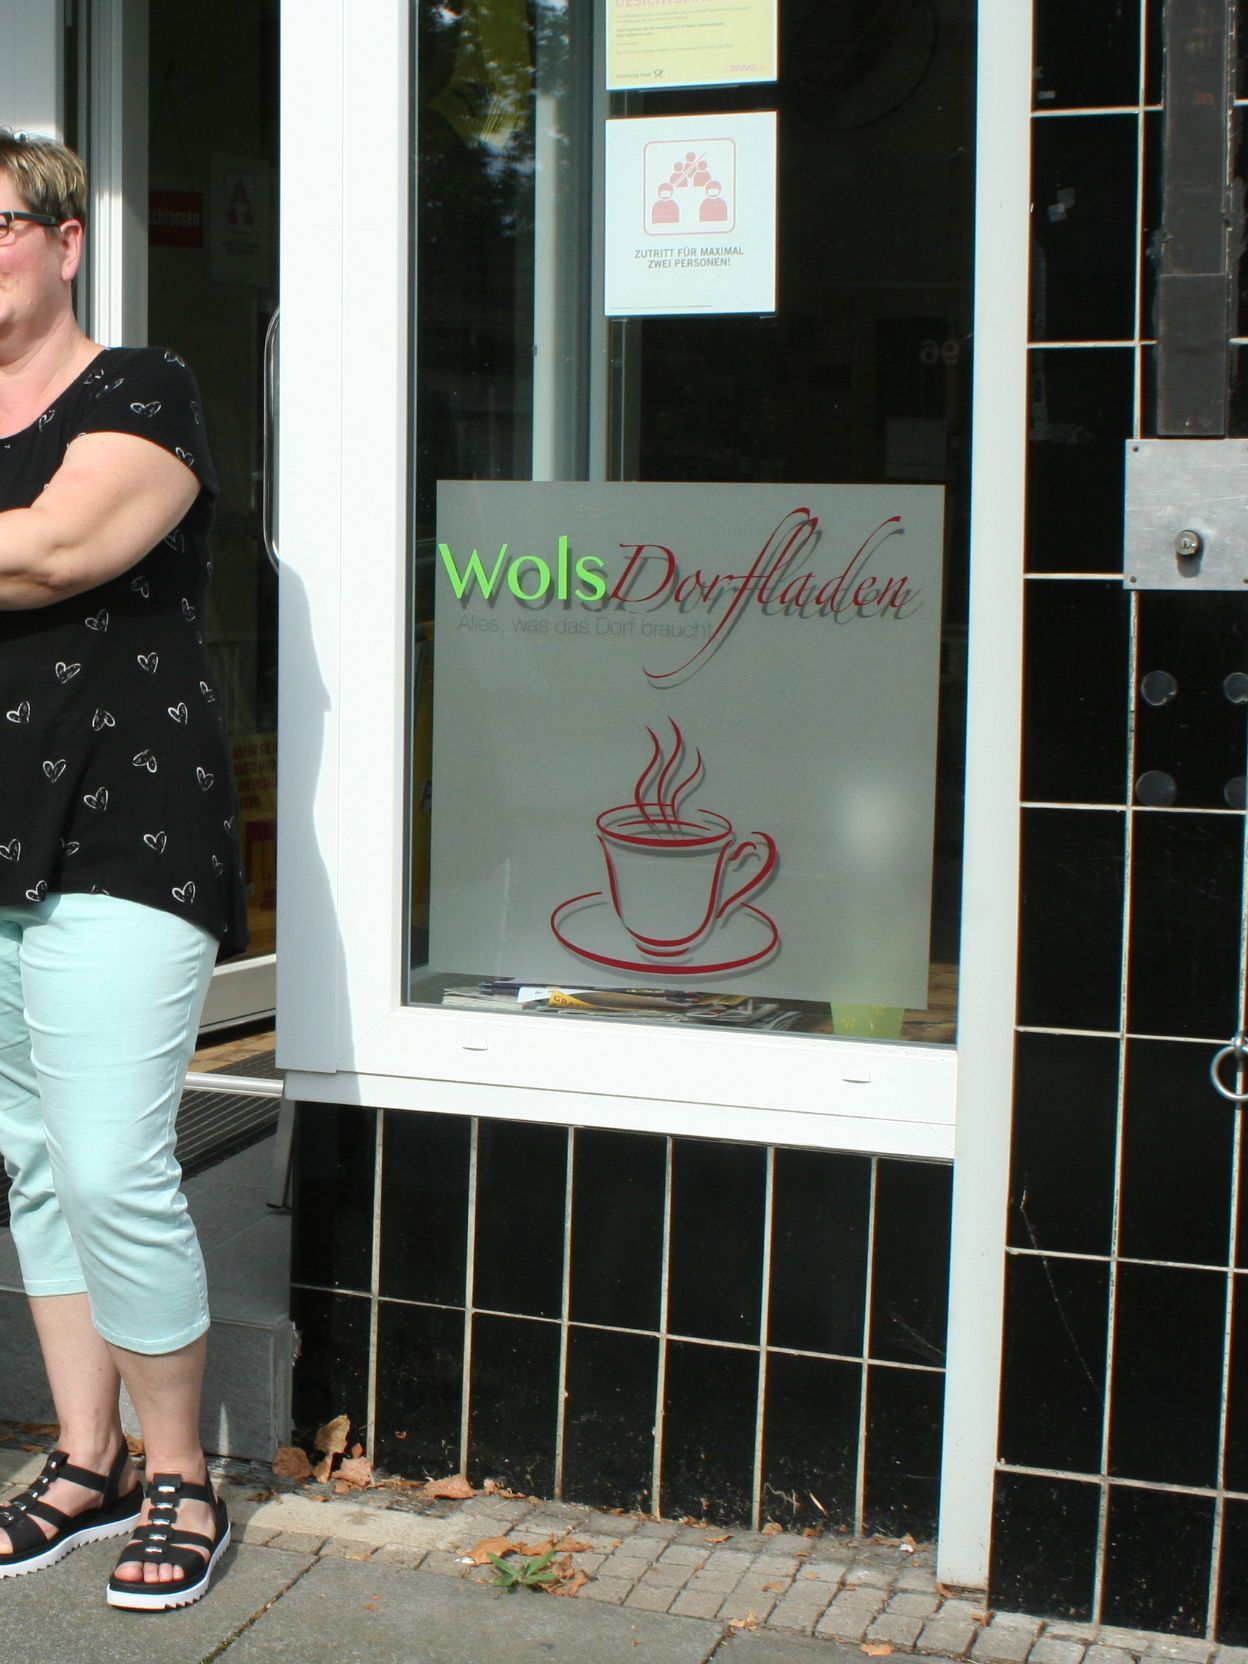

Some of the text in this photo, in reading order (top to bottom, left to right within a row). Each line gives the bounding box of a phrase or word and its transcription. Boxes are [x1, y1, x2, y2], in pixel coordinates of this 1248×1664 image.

[634, 246, 745, 259] ZUTRITT FÜR MAXIMAL
[647, 257, 731, 269] ZWEI PERSONEN!
[512, 618, 550, 634] was
[555, 615, 590, 634] das
[595, 616, 636, 636] Dorf
